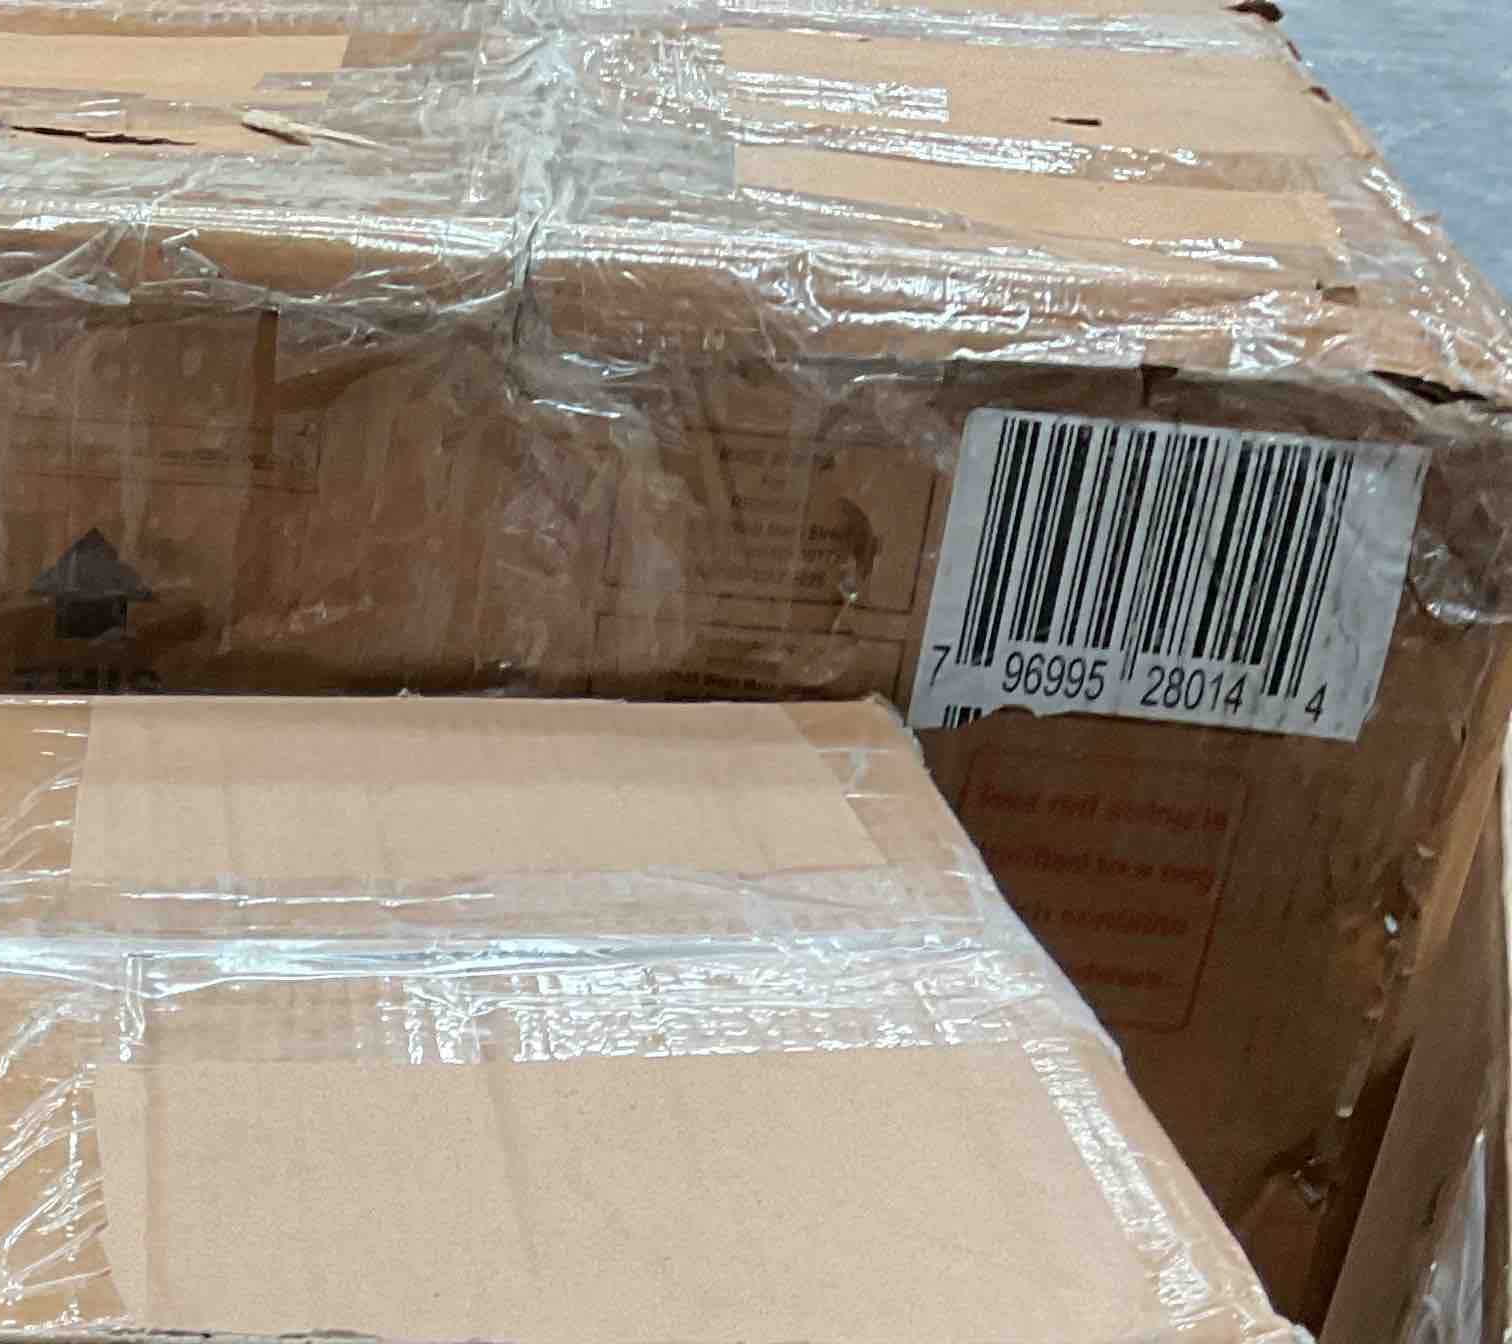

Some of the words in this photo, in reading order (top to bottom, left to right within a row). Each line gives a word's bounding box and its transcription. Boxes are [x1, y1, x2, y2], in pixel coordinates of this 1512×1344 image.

[930, 645, 951, 687] 7
[1002, 651, 1108, 701] 96995
[1140, 664, 1248, 714] 28014
[1304, 684, 1328, 724] 4
